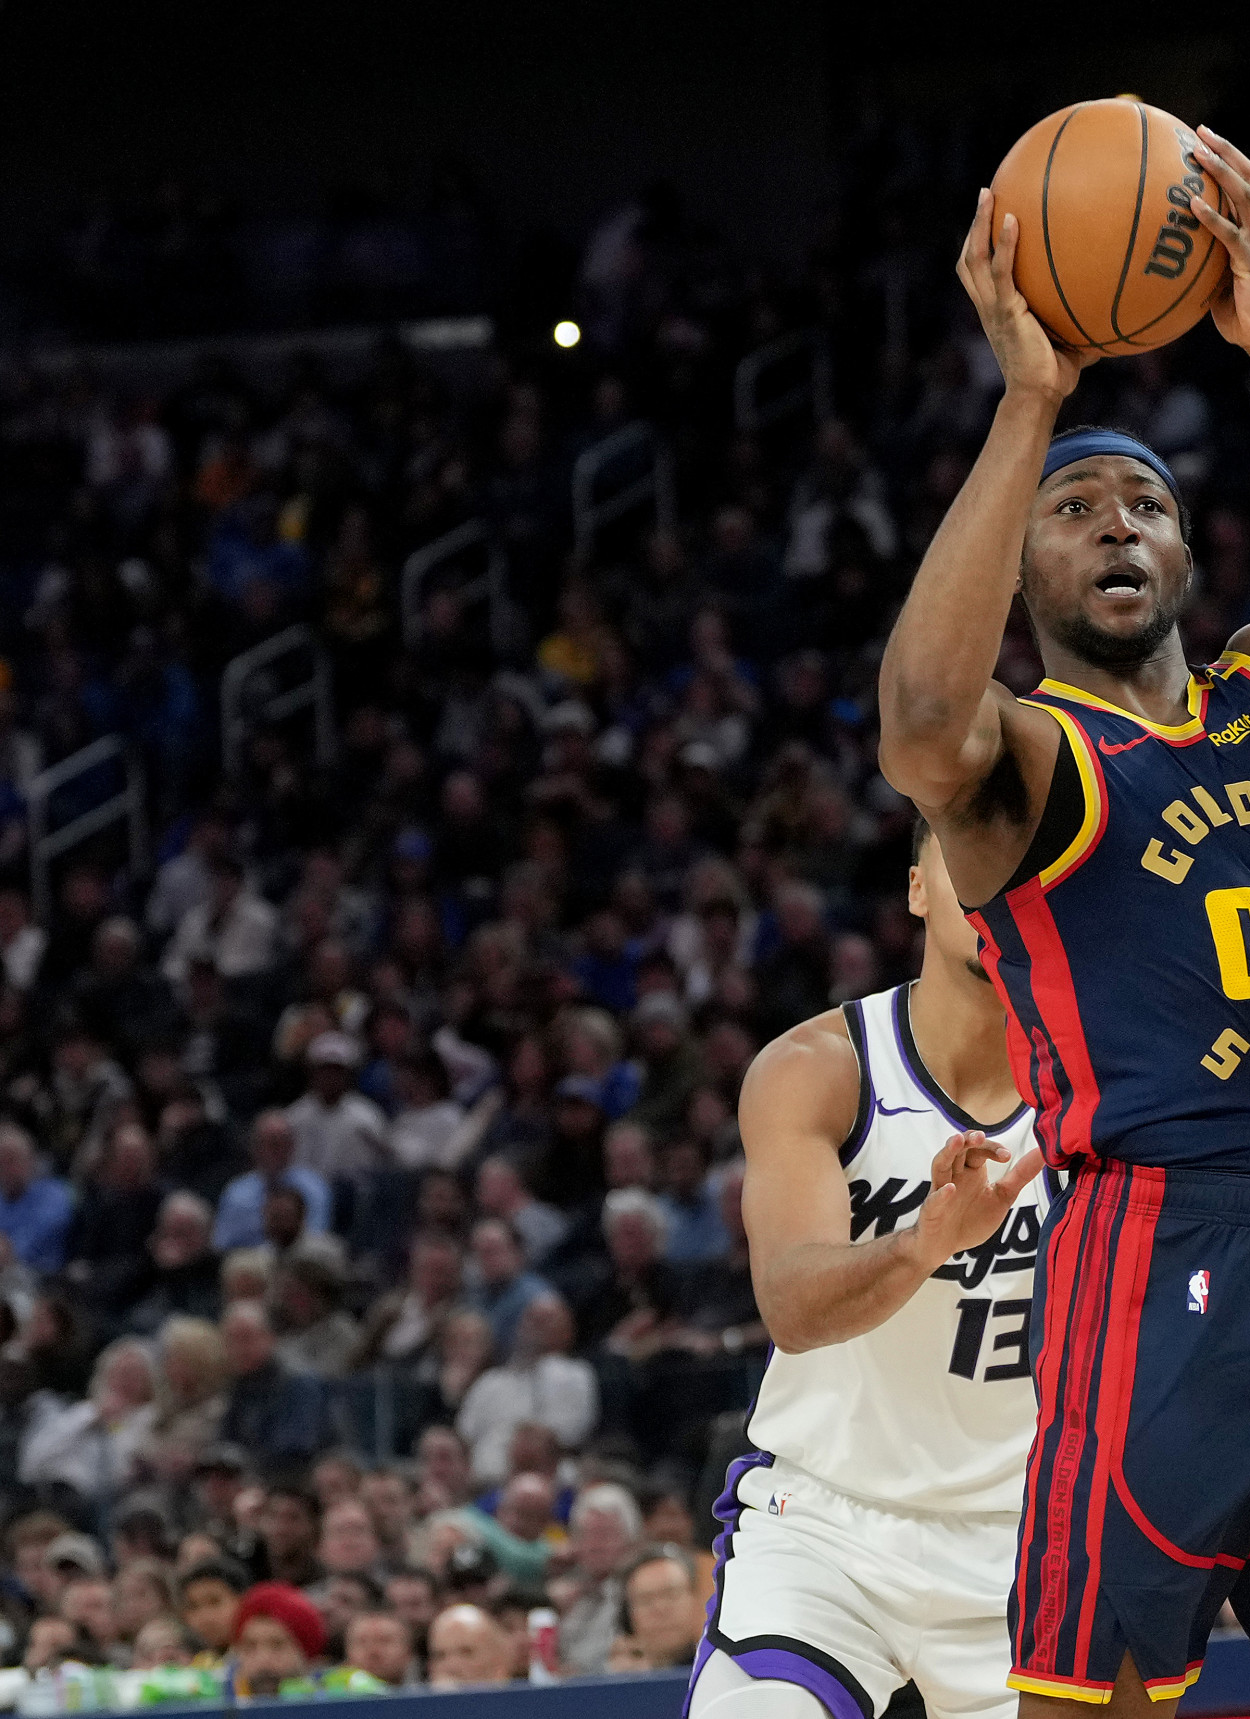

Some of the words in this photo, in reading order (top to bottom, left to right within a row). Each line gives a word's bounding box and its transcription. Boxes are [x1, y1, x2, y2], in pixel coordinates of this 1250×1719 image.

[948, 1298, 1033, 1383] 13
[1055, 1433, 1079, 1504] GOLDEN
[1051, 1506, 1065, 1565] STATE
